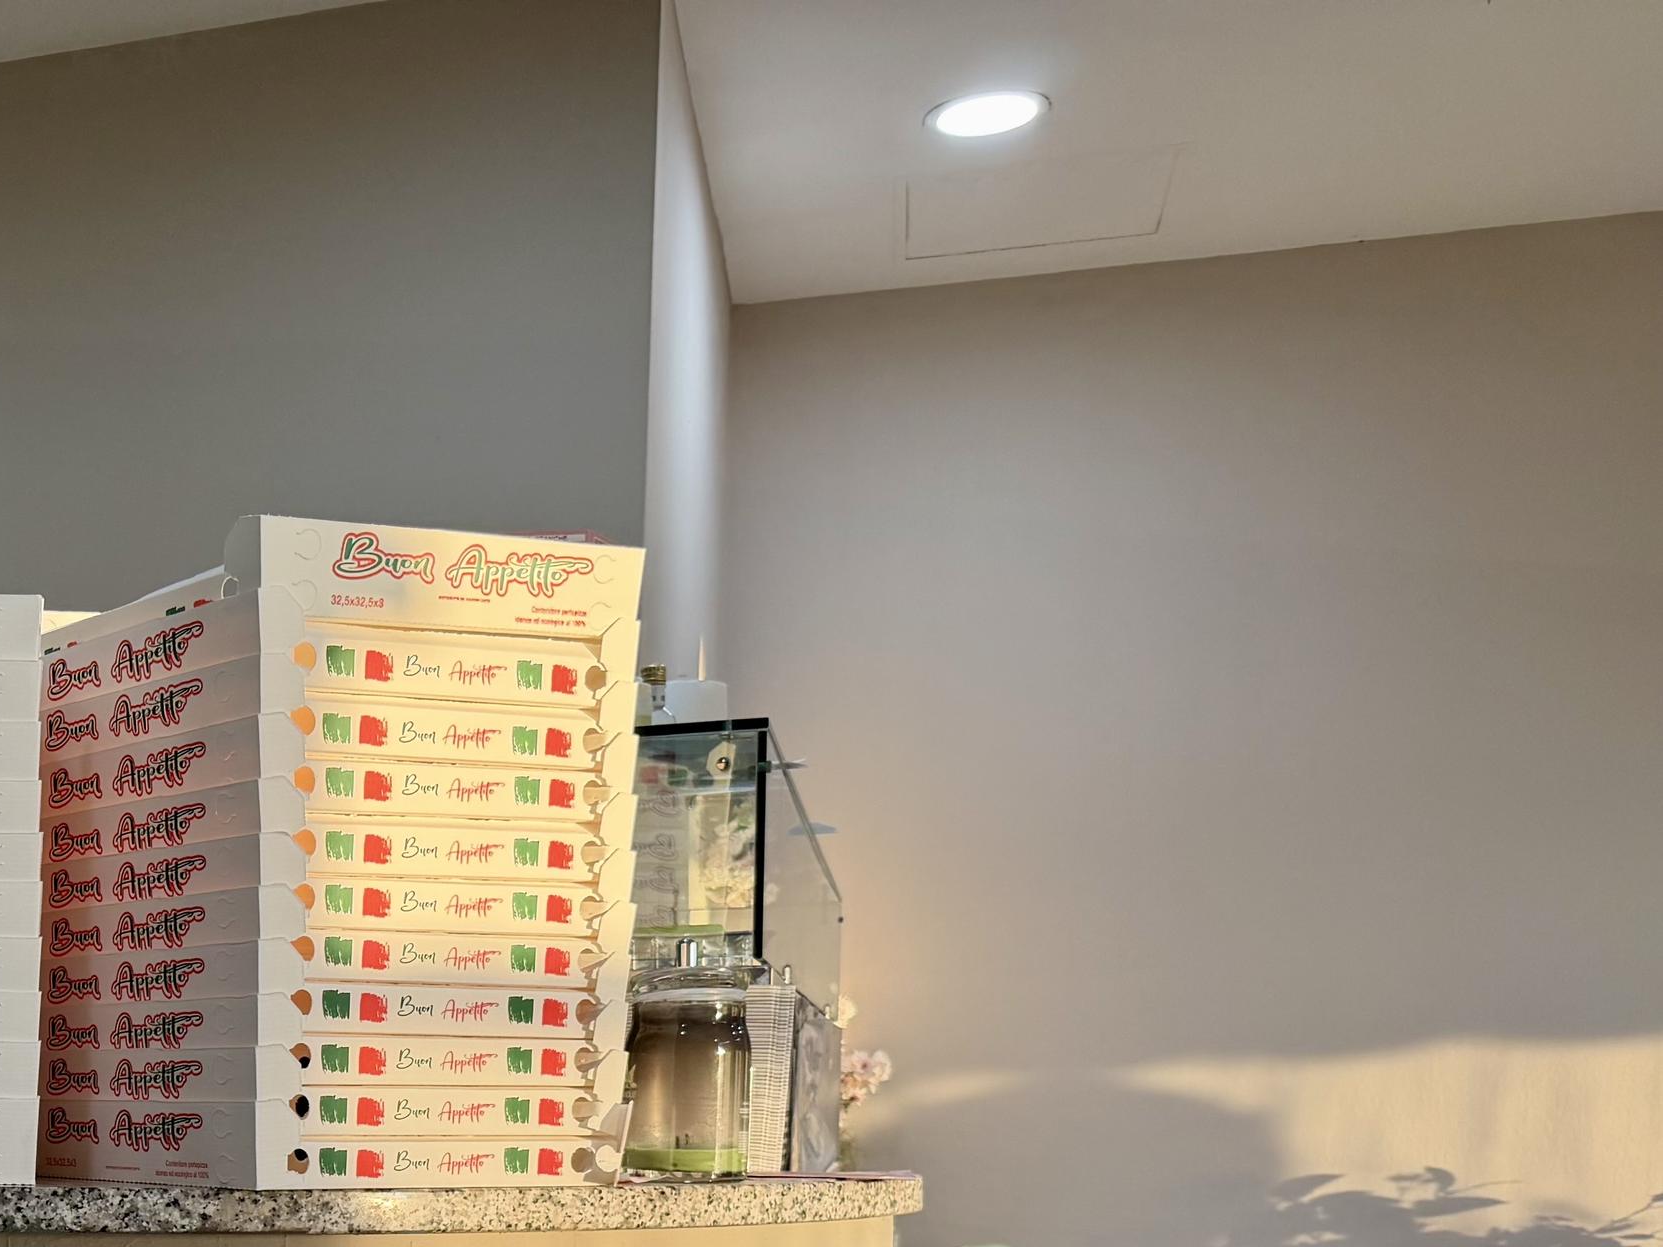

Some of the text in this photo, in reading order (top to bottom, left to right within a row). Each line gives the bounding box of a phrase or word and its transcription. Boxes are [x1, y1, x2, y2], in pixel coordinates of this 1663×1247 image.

[332, 531, 593, 598] Buon Appetito
[331, 594, 385, 608] 32,5x32,5x3
[47, 620, 204, 701] Buon Appetito
[403, 654, 507, 685] Buon Appetito
[45, 678, 203, 752] Buon Appetito
[399, 721, 502, 749] Buon Appetito
[49, 742, 206, 809] Buon Appetito
[401, 774, 505, 803] Buon Appetito
[49, 802, 206, 862] Buon Appetito
[401, 837, 505, 863] Buon Appetito
[49, 855, 206, 908] Buon Appetito
[401, 891, 504, 917] Buon Appetito
[49, 906, 206, 956] Buon Appetito
[399, 943, 502, 970] Buon Appetito
[49, 958, 205, 1004] Buon Appetito
[398, 995, 500, 1023] Buon Appetito
[48, 1011, 203, 1051] Buon Appetito
[396, 1047, 498, 1075] Buon Appetito
[46, 1058, 203, 1100] Buon Appetito
[394, 1098, 496, 1125] Buon Appetito
[46, 1107, 203, 1152] Buon Appetito
[393, 1151, 495, 1176] Buon Appetito
